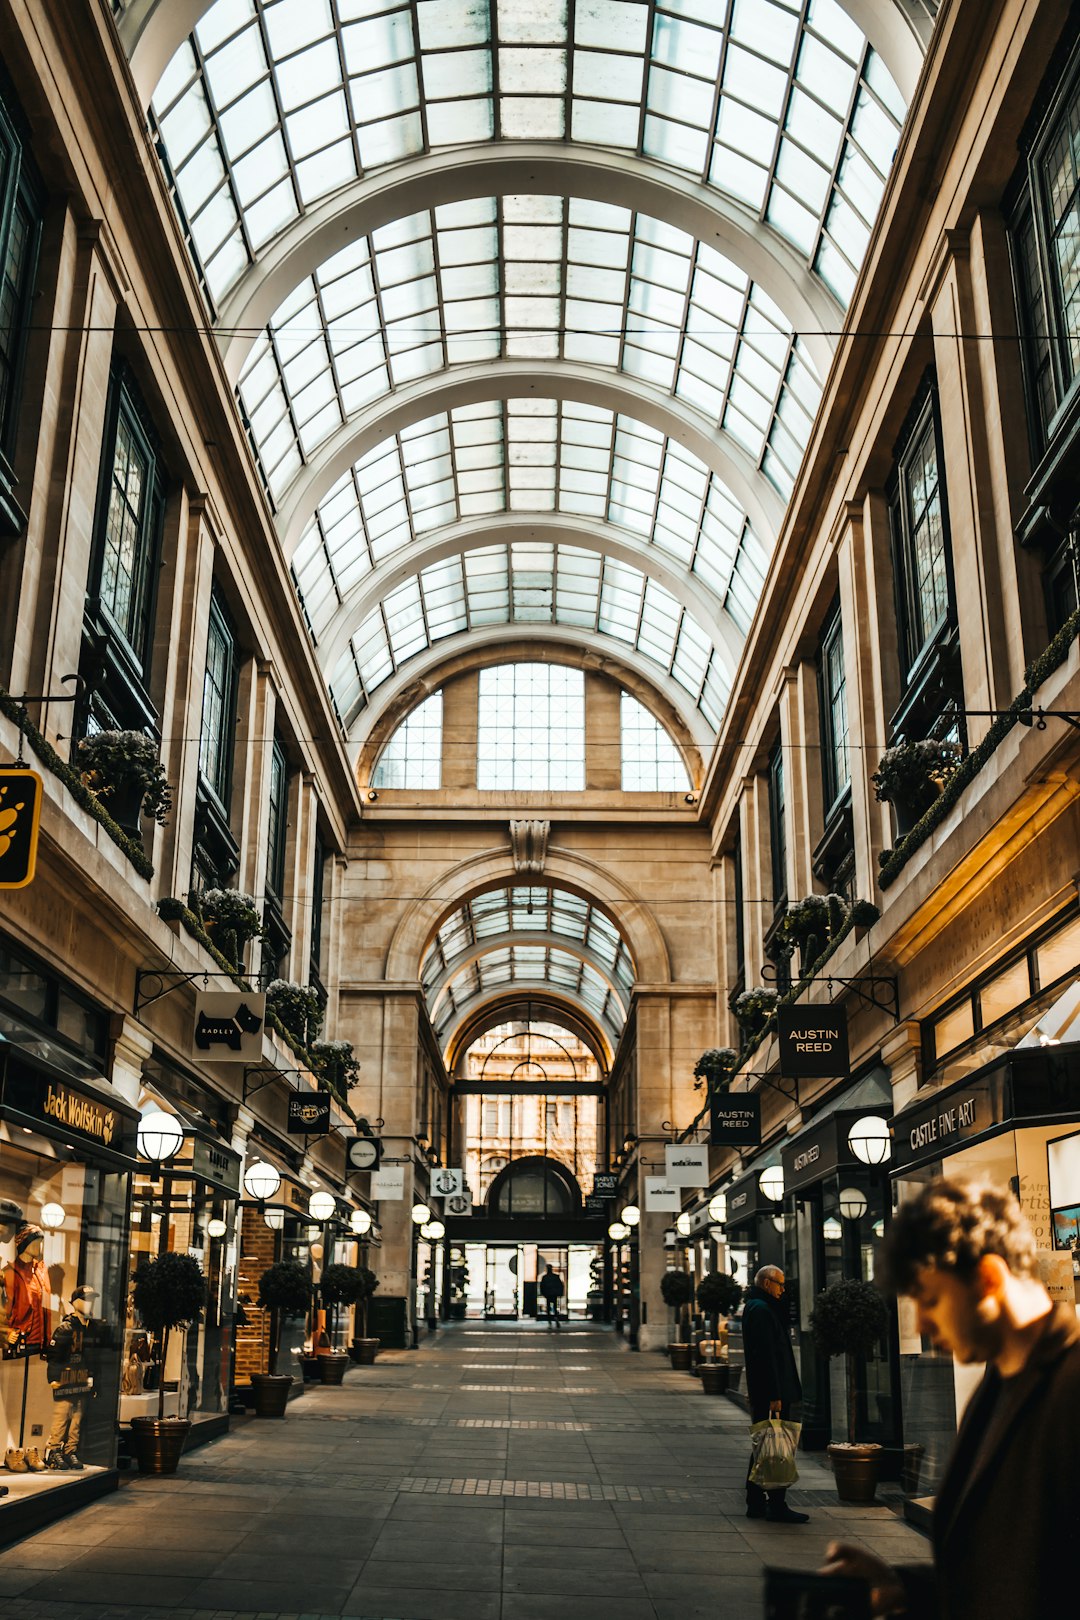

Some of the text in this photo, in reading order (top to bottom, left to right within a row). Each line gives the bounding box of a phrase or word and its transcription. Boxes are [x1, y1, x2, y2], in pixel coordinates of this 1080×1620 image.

[789, 1030, 838, 1040] AUSTIN
[796, 1043, 832, 1052] REED
[44, 1086, 102, 1136] Jack Wolfskin
[910, 1098, 974, 1150] CASTLE FINE ART
[807, 1144, 820, 1162] REED
